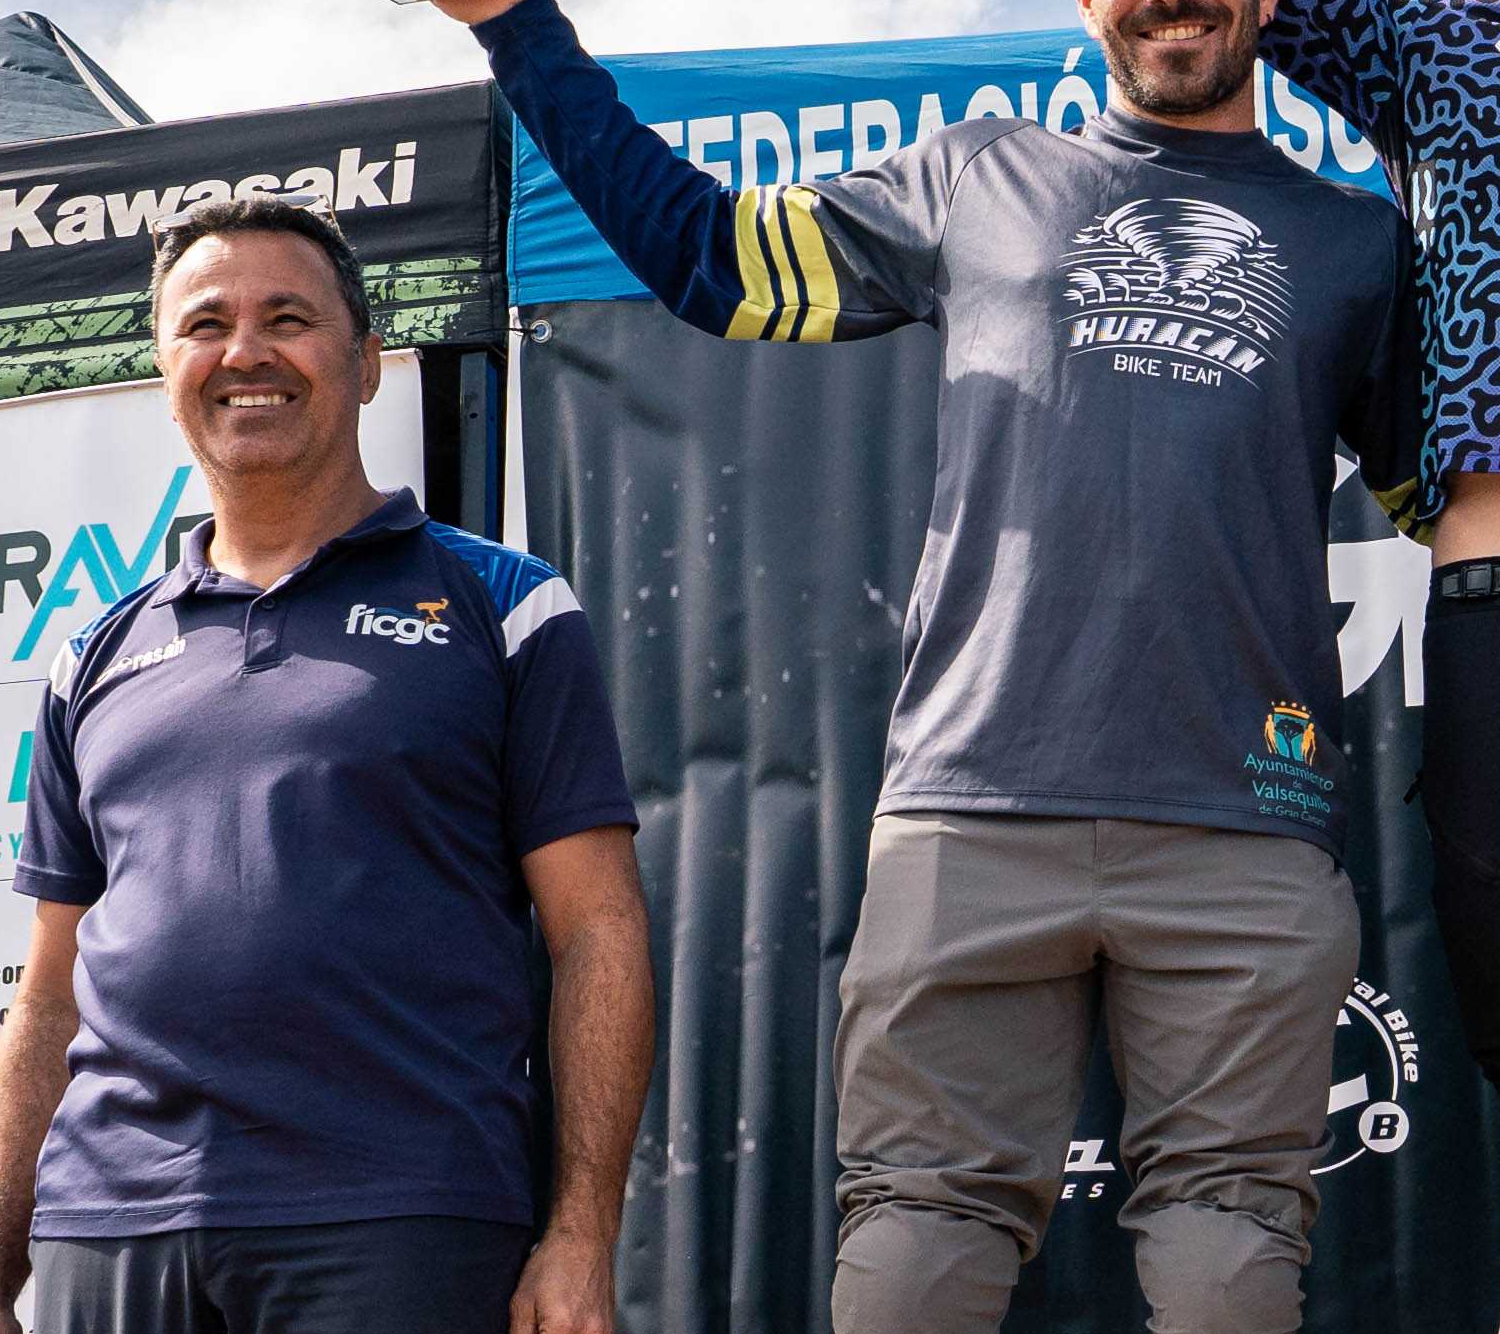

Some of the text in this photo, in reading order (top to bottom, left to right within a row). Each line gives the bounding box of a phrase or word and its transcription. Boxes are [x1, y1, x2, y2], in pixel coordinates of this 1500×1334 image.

[648, 47, 1112, 191] EDERIÓ
[1069, 316, 1266, 374] HURACÁN
[1113, 353, 1223, 387] BIKE TEAM
[345, 604, 452, 646] ficgc
[1382, 1008, 1419, 1083] Bike
